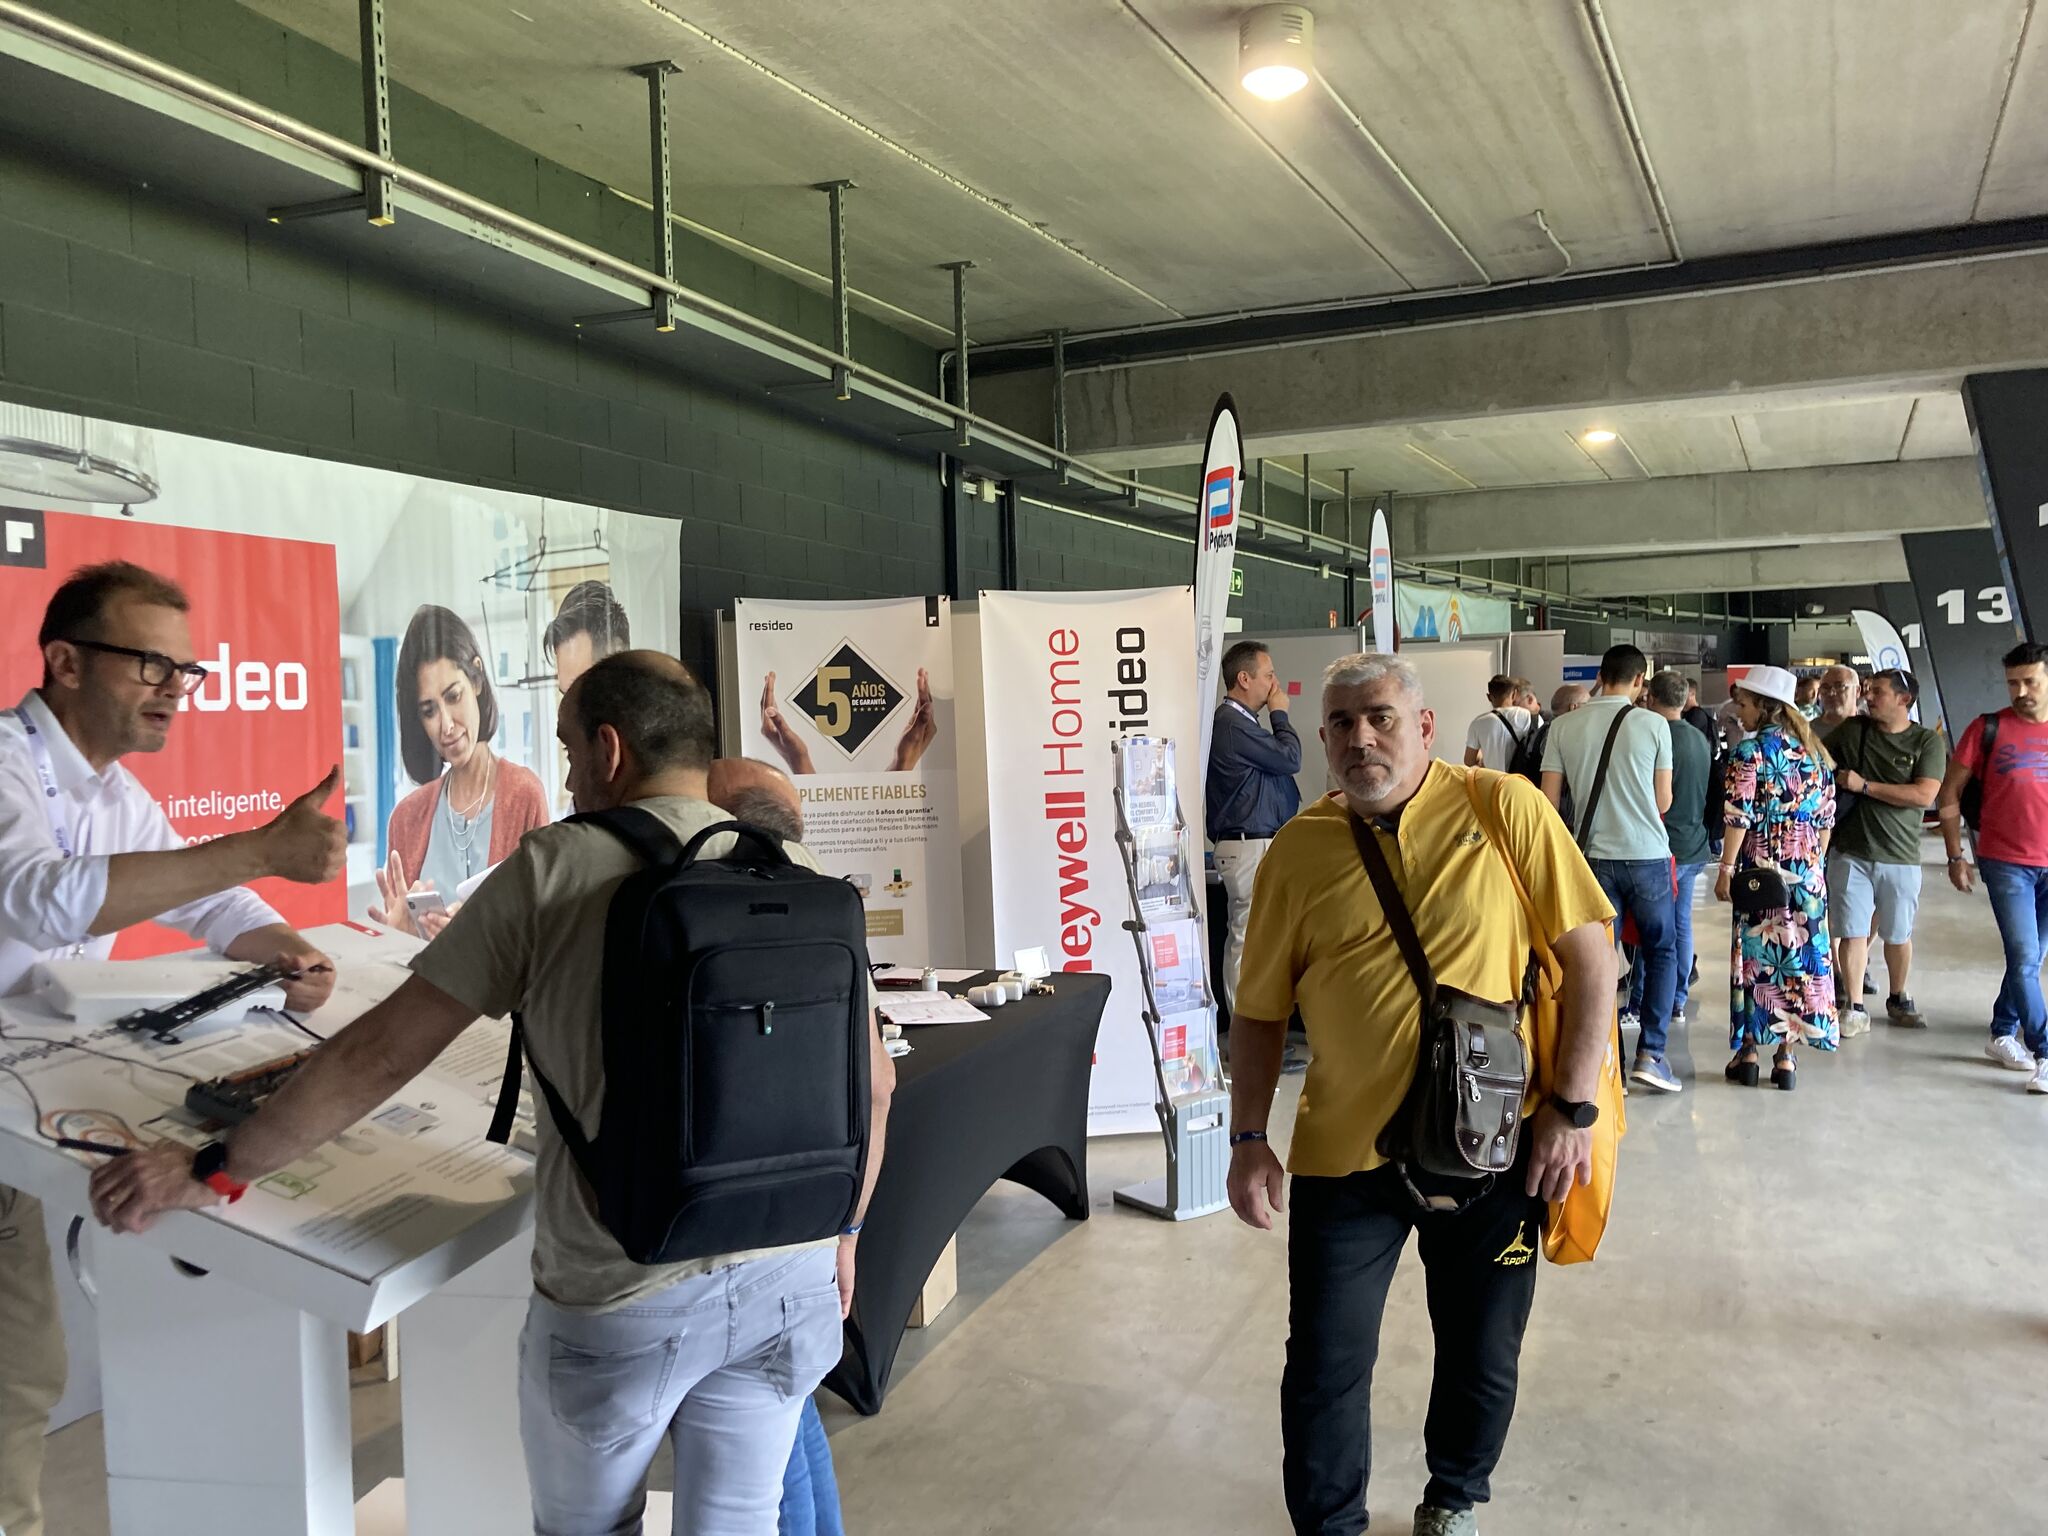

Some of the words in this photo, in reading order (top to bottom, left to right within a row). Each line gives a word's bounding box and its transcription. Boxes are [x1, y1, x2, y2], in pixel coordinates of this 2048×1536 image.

[1936, 586, 2013, 625] 13
[749, 620, 793, 631] resideo
[851, 680, 886, 698] AÑOS
[1107, 627, 1149, 739] ideo
[814, 665, 851, 737] 5
[859, 697, 887, 706] GARANTÍA
[1042, 629, 1084, 776] Home
[168, 789, 286, 820] inteligente,
[799, 786, 869, 803] PLEMENTE
[872, 784, 927, 800] FIABLES
[804, 818, 830, 826] ontroles
